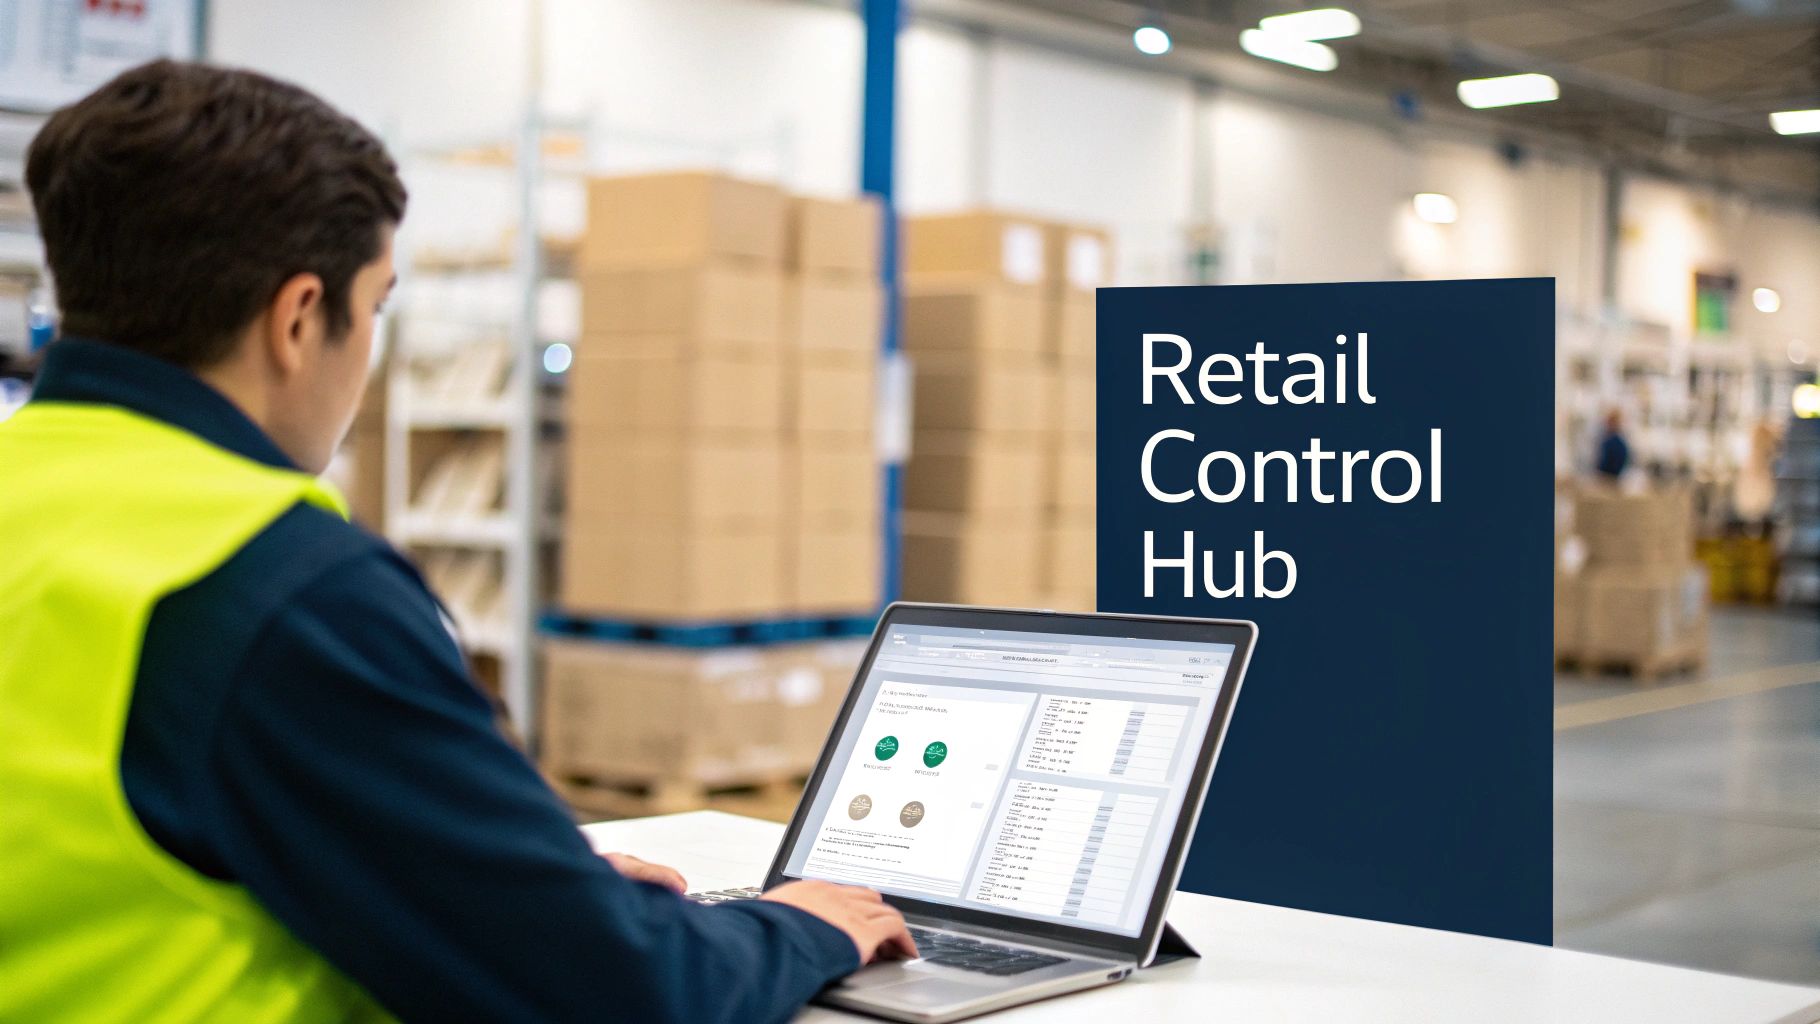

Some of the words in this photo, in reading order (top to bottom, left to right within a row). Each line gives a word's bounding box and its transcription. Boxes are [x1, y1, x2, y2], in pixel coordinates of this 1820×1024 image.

[1142, 333, 1376, 405] Retail
[1140, 428, 1442, 504] Control
[1143, 530, 1298, 599] Hub
